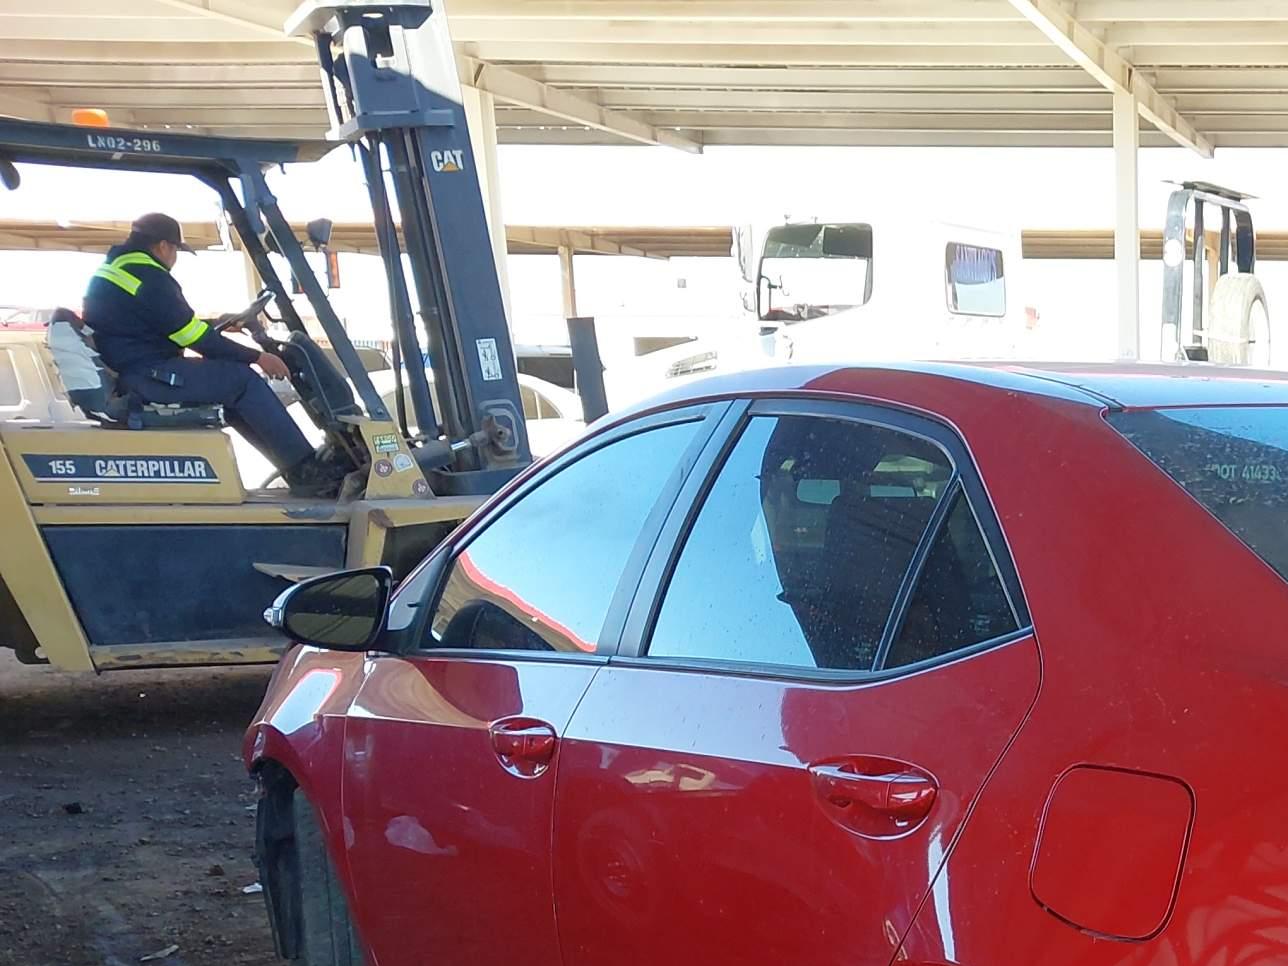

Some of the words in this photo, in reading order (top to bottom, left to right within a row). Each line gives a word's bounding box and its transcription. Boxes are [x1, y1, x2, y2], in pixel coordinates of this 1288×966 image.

[431, 150, 464, 172] CAT
[48, 460, 76, 474] 155
[95, 460, 207, 477] CATERPILLAR
